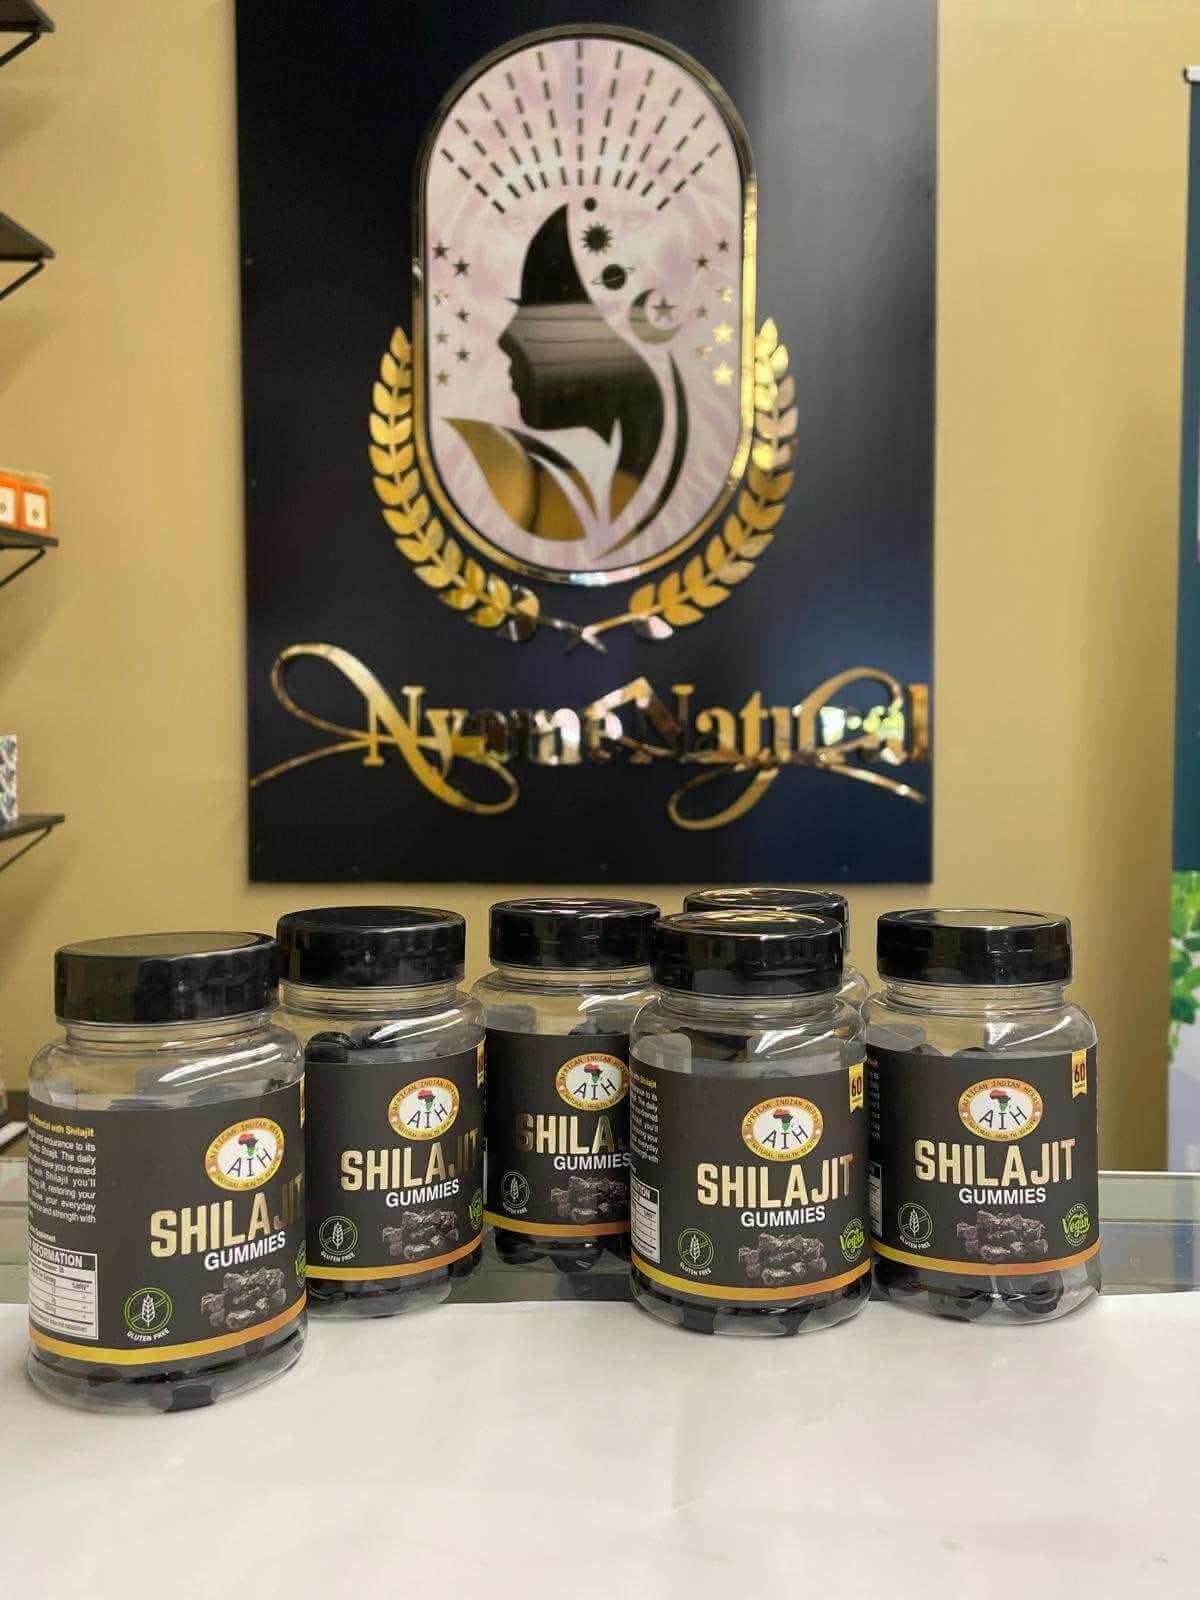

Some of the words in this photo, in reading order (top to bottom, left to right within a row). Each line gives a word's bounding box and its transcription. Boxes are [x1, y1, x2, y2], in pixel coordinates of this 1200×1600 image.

[1074, 1063, 1085, 1083] 60
[573, 1078, 617, 1100] AIH
[851, 1076, 862, 1097] 60
[407, 1103, 448, 1129] AIH
[979, 1106, 1028, 1130] AIH
[75, 1142, 83, 1151] to
[85, 1143, 96, 1152] its
[762, 1125, 809, 1149] AIH
[67, 1164, 96, 1176] drained
[77, 1153, 96, 1166] daily
[226, 1148, 272, 1178] AIH
[553, 1152, 632, 1171] GUMMIES
[914, 1138, 1076, 1187] SHILAJIT
[72, 1178, 96, 1188] you'll
[696, 1153, 854, 1209] SHILAJIT
[78, 1190, 96, 1200] your
[386, 1178, 460, 1208] GUMMIES
[959, 1187, 1046, 1205] GUMMIES
[60, 1199, 96, 1213] everyday
[741, 1205, 826, 1228] GUMMIES
[79, 1214, 96, 1224] with
[1062, 1215, 1090, 1237] Vegan
[203, 1231, 287, 1271] GUMMIES
[126, 1331, 152, 1342] GLUTEN
[153, 1327, 171, 1342] FREE
